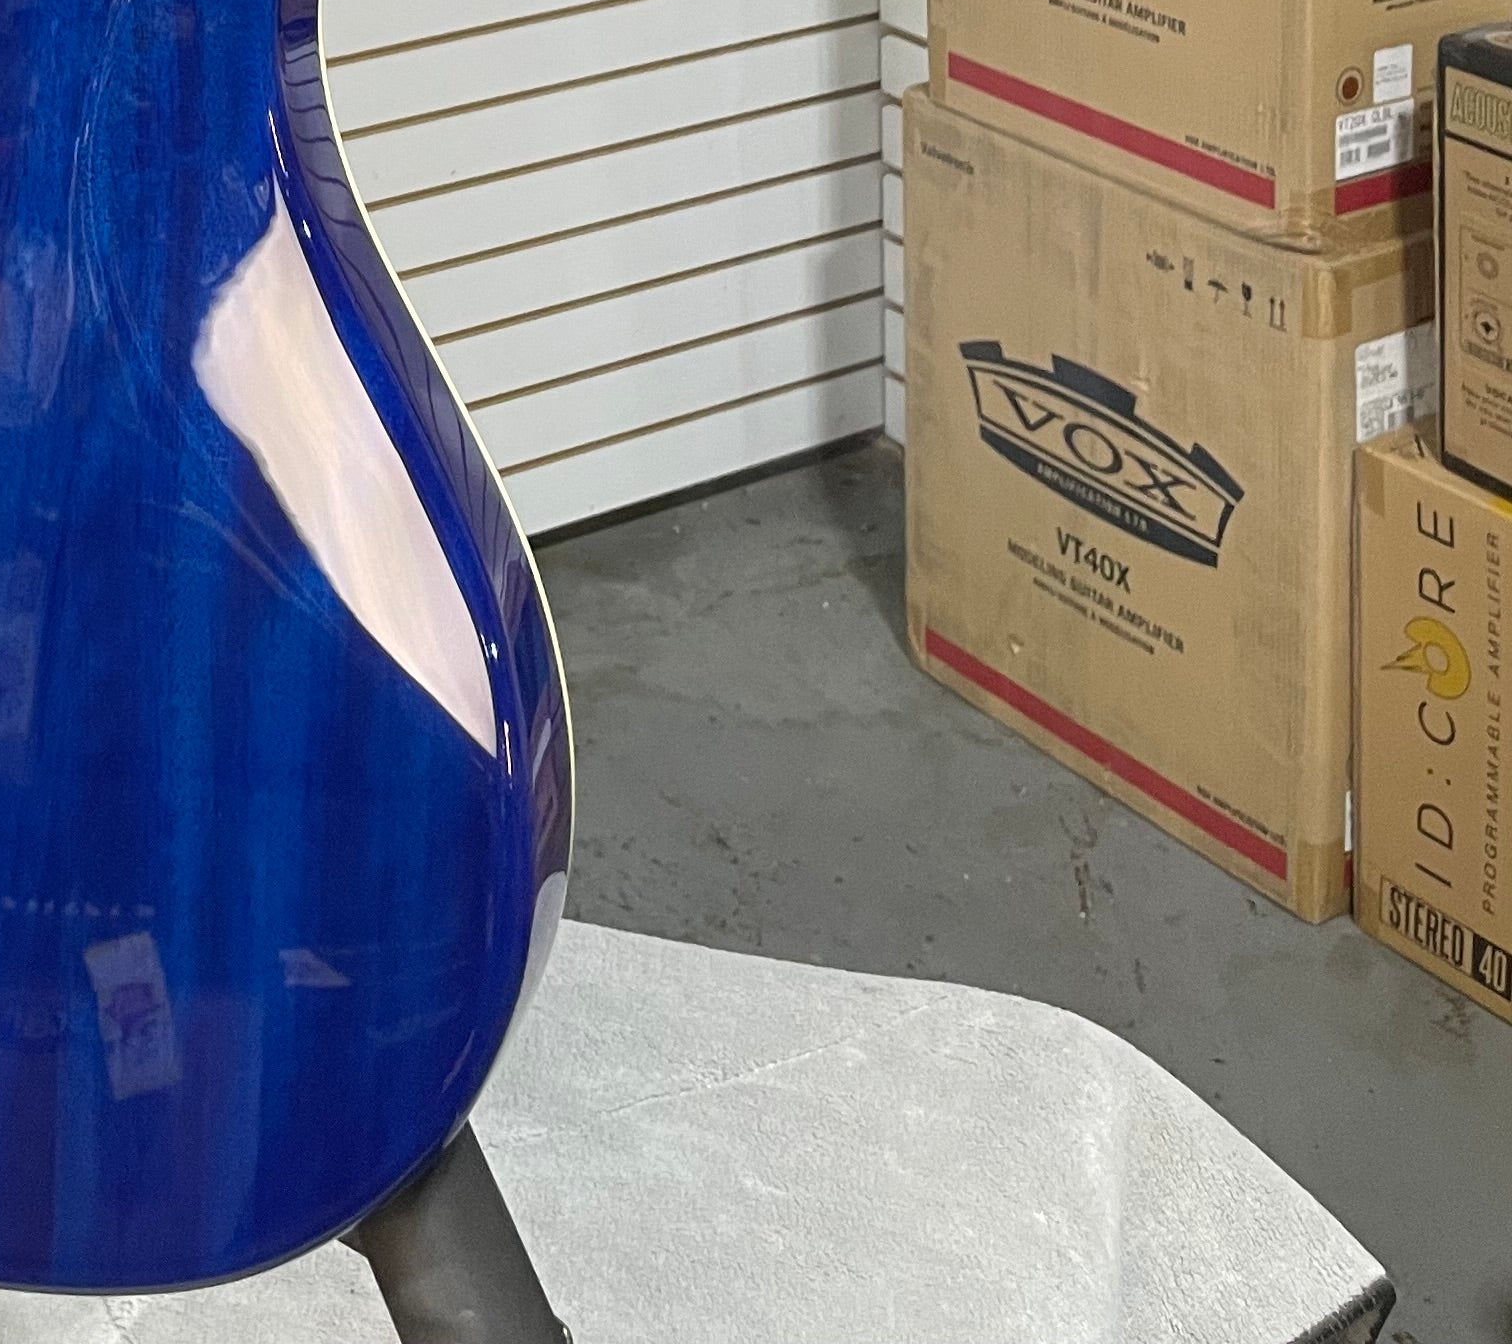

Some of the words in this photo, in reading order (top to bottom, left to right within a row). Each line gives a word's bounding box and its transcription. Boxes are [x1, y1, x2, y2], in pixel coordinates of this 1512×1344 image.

[1126, 1, 1186, 36] AMPLIFIER
[993, 379, 1197, 522] VOX
[1056, 526, 1131, 594] VT40X
[1485, 531, 1500, 679] AMPLIFIER
[1482, 690, 1500, 916] PROGRAMMABLE
[1388, 884, 1465, 967] STEREO
[1478, 944, 1508, 993] 40
